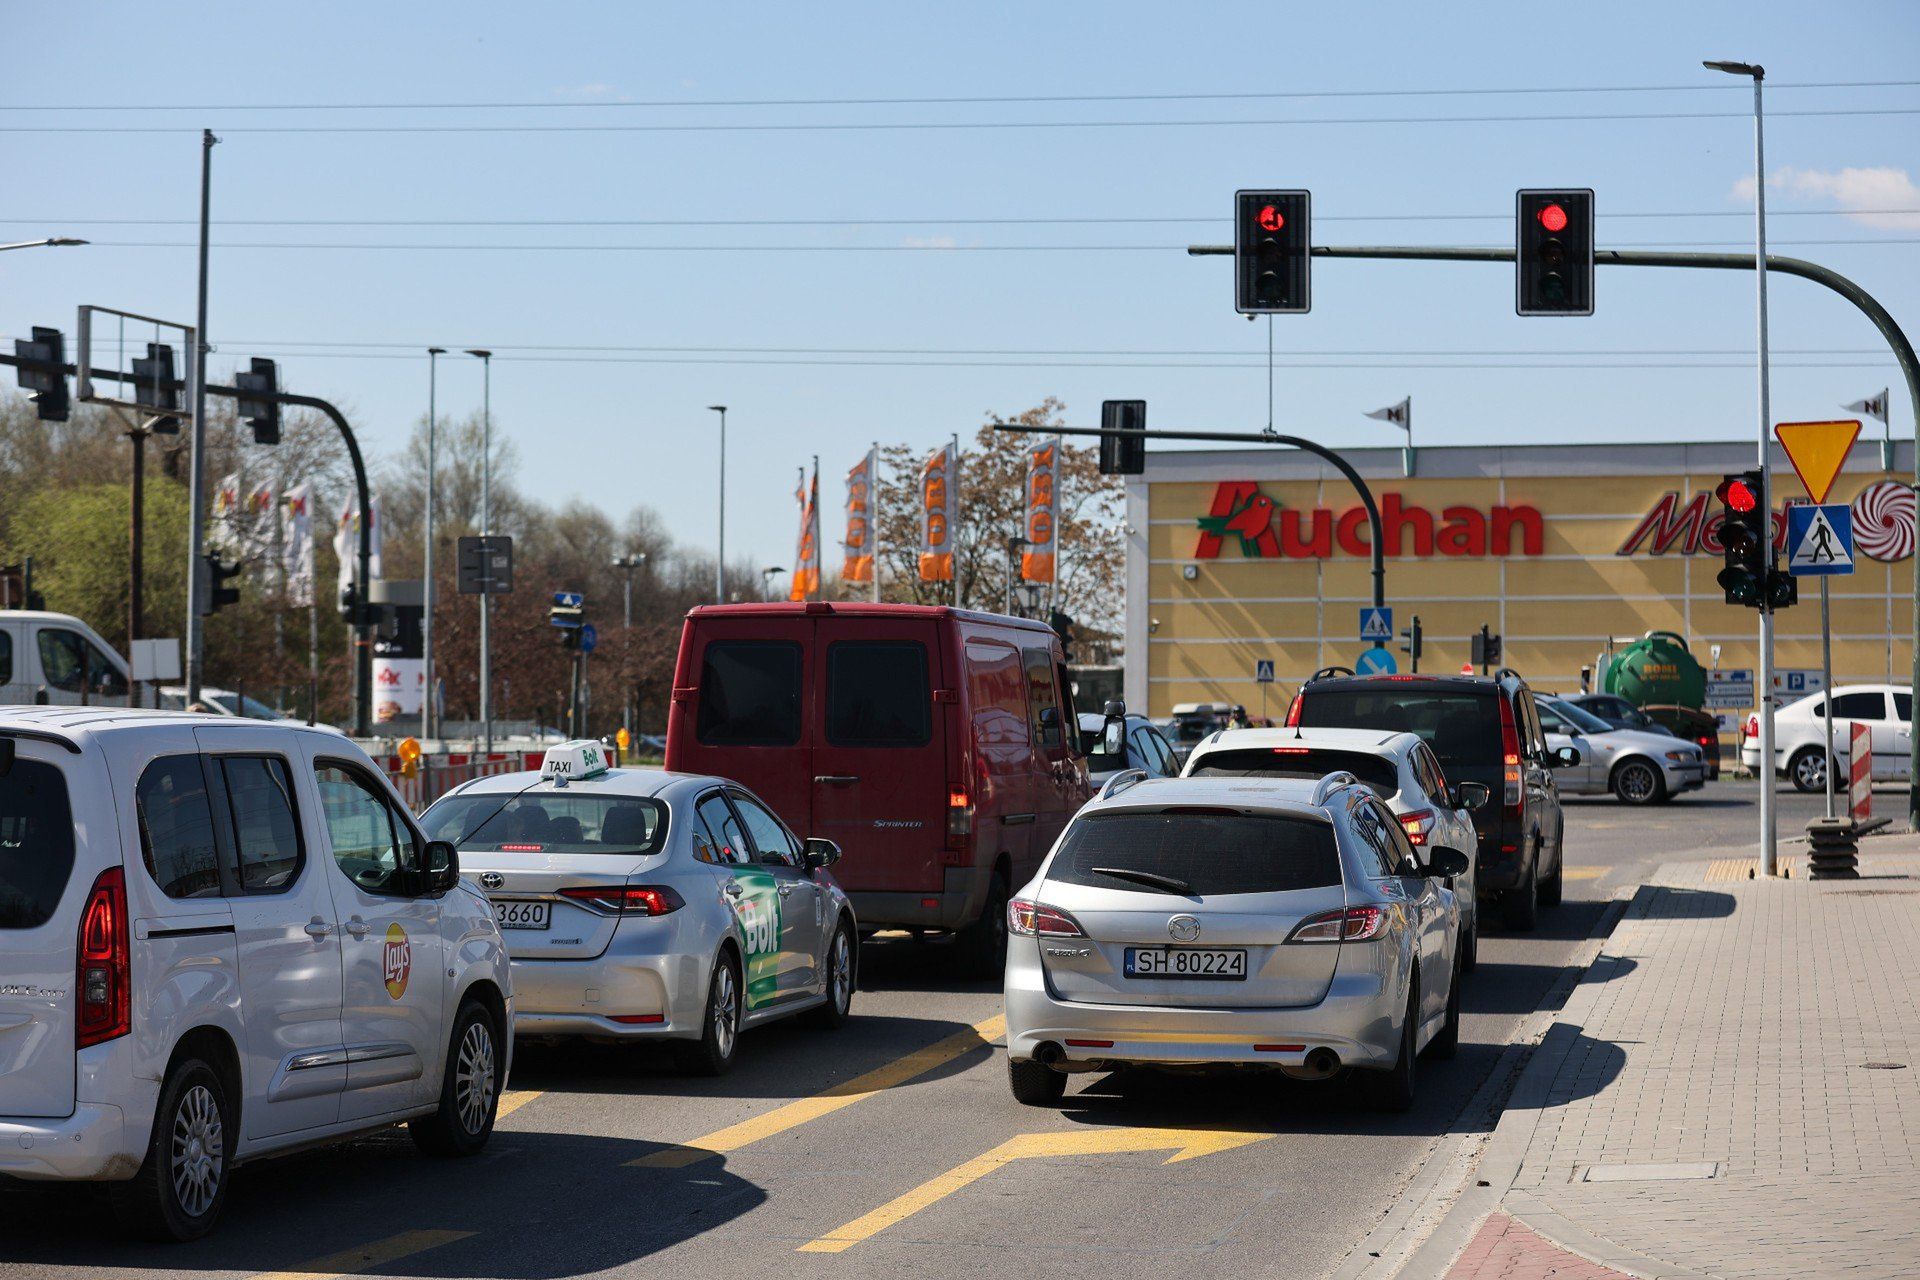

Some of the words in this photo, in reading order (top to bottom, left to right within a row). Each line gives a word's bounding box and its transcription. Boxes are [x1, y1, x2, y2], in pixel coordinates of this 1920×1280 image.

[1195, 481, 1543, 558] Auchan
[549, 760, 572, 772] TAXI
[582, 747, 599, 769] Bolt
[491, 903, 544, 922] 3660
[744, 899, 779, 955] Bolt
[385, 938, 410, 983] Lay's
[1138, 951, 1168, 973] SH
[1176, 952, 1242, 974] 80224
